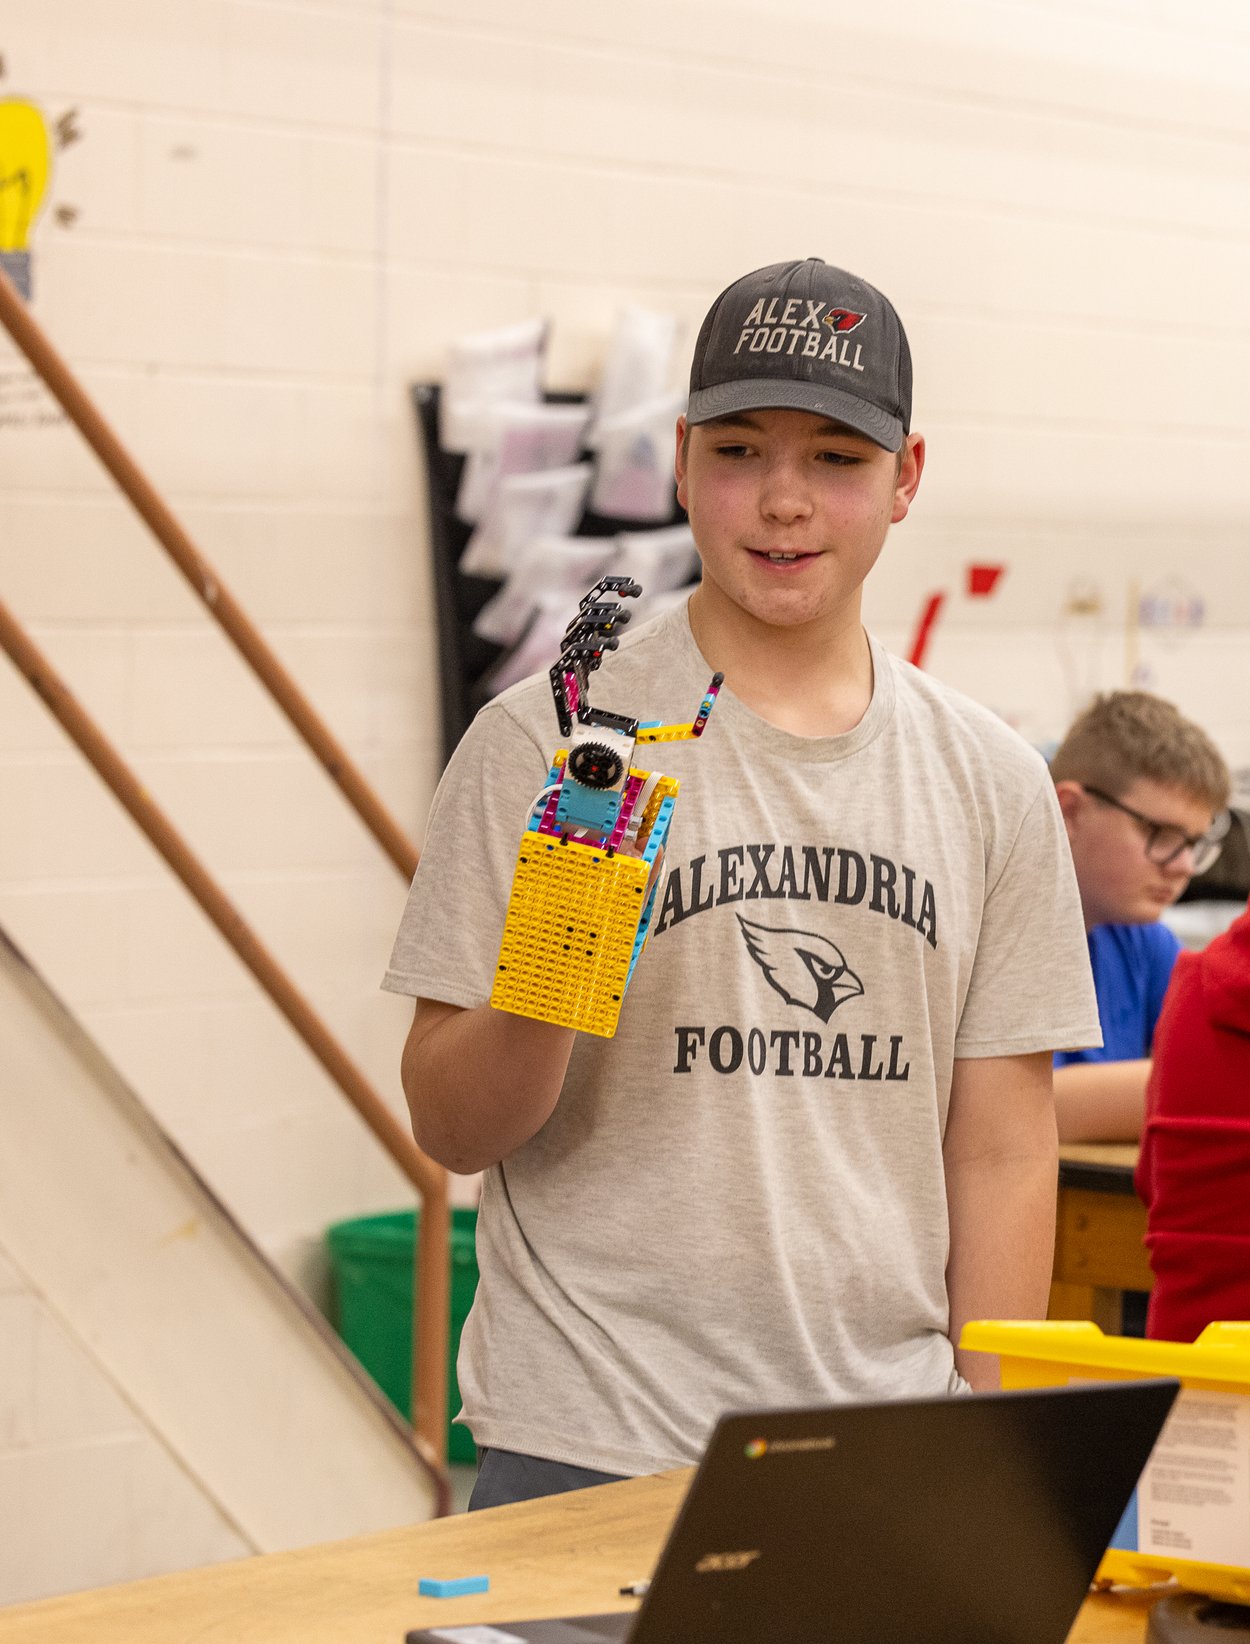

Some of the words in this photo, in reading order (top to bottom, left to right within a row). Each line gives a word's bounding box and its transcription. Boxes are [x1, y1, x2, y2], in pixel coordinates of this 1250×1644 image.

[743, 298, 826, 329] ALEX
[733, 327, 865, 371] FOOTBALL
[654, 843, 938, 950] ALEXANDRIA
[673, 1026, 911, 1081] FOOTBALL
